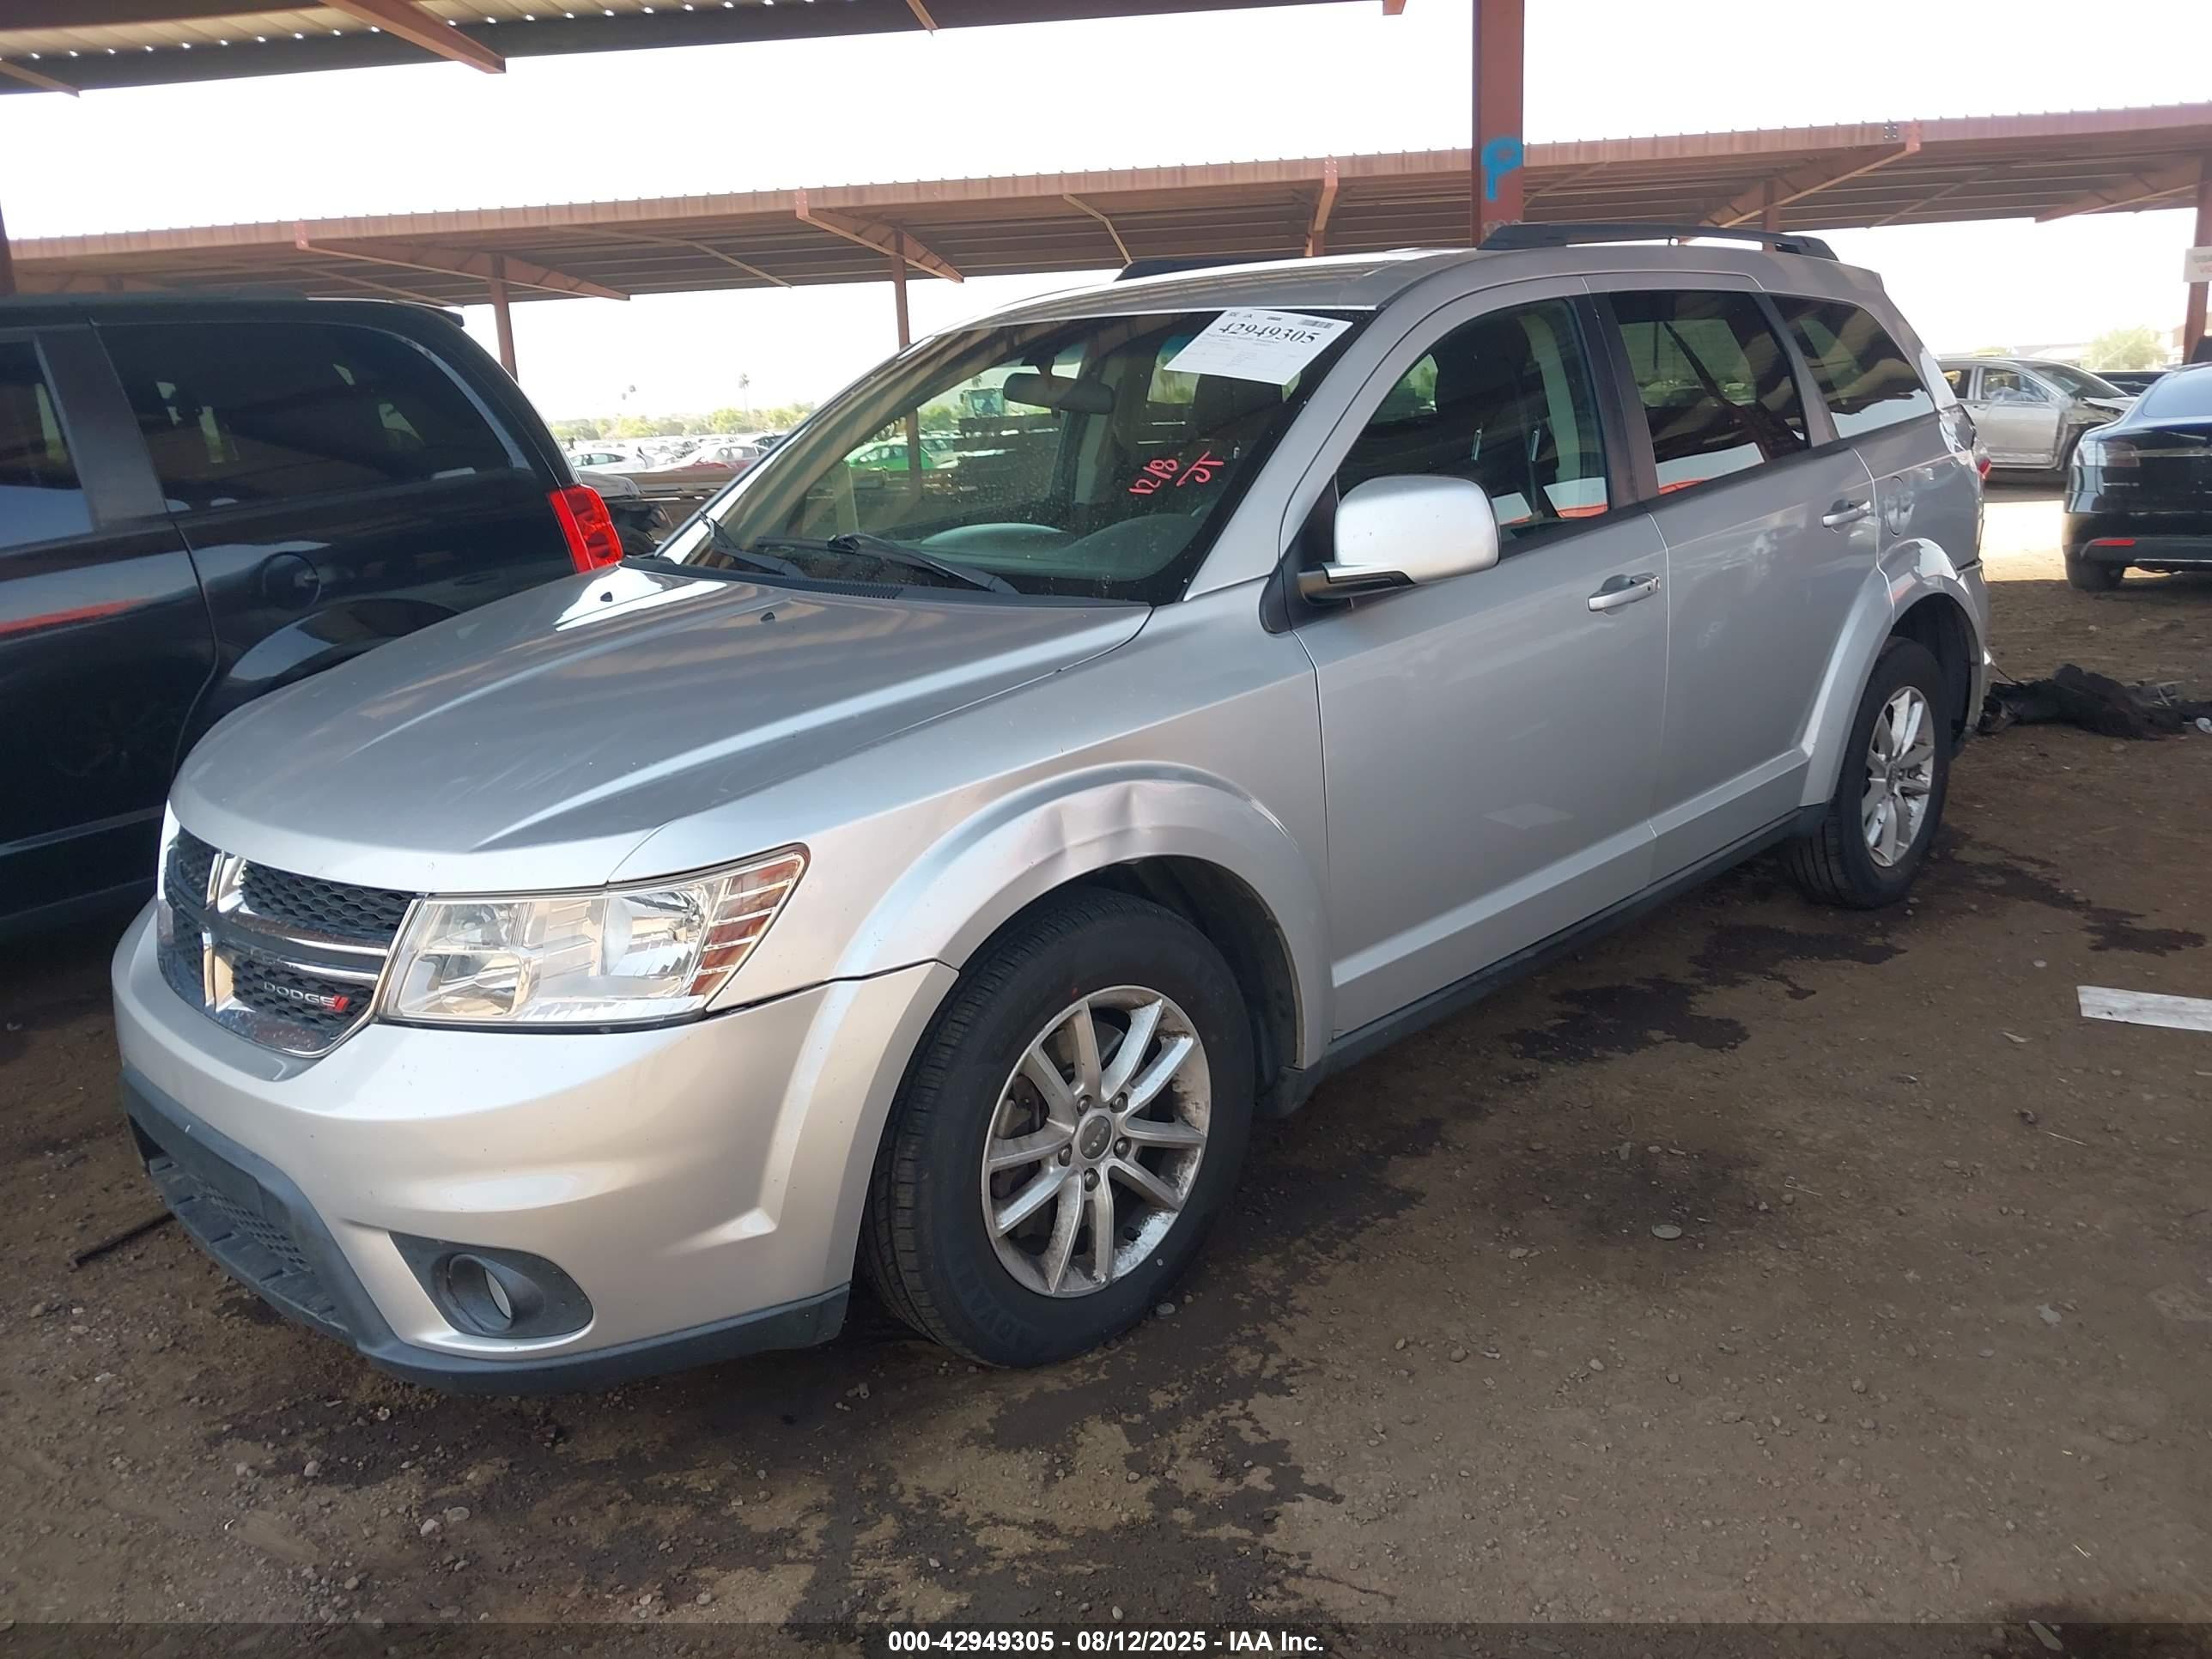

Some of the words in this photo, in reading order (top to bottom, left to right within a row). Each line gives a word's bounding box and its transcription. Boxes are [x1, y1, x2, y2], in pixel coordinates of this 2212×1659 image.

[1481, 136, 1523, 201] P
[1218, 322, 1321, 343] 42949305
[264, 981, 337, 1008] DODGE
